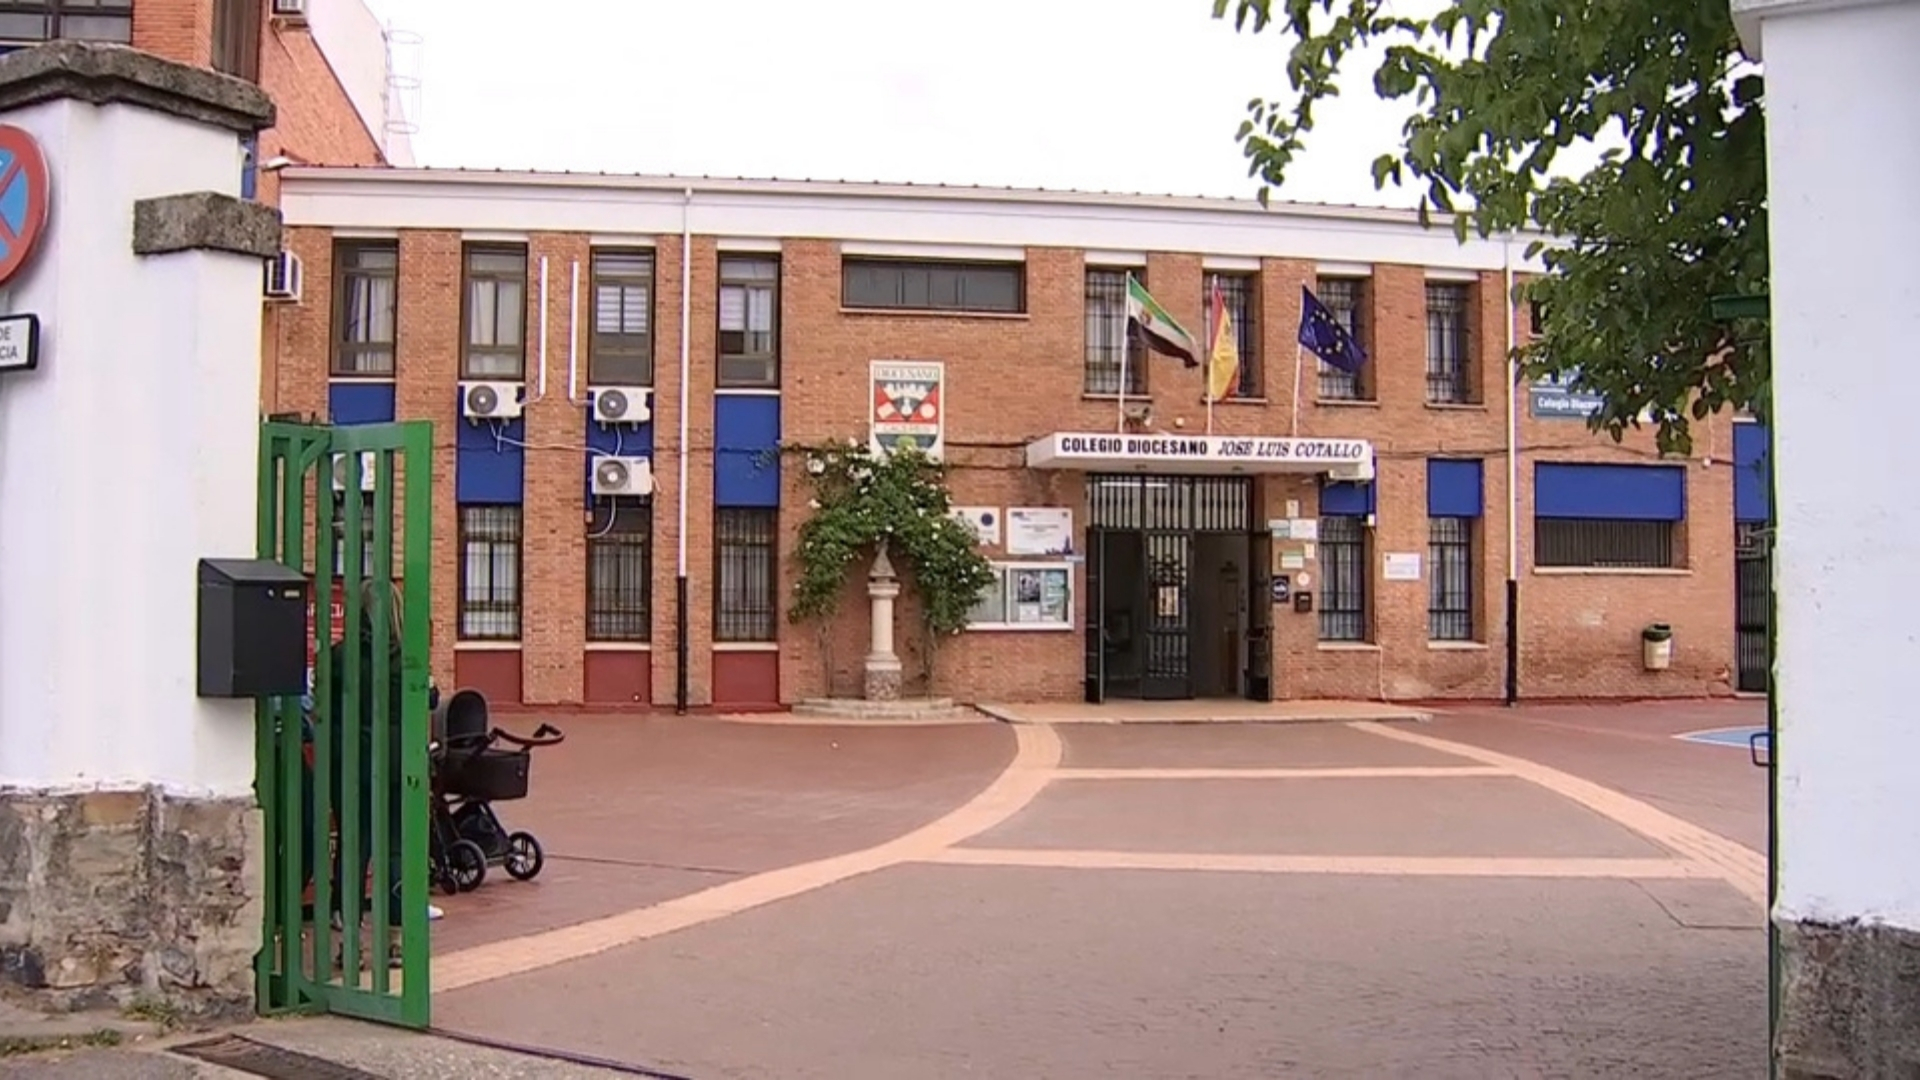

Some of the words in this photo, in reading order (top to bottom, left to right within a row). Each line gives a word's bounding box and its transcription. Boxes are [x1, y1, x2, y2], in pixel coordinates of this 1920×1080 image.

[1061, 437, 1123, 453] COLEGIO
[1127, 439, 1209, 455] DIOCESANO
[1256, 441, 1291, 457] LUIS
[1295, 442, 1363, 459] COTALLO
